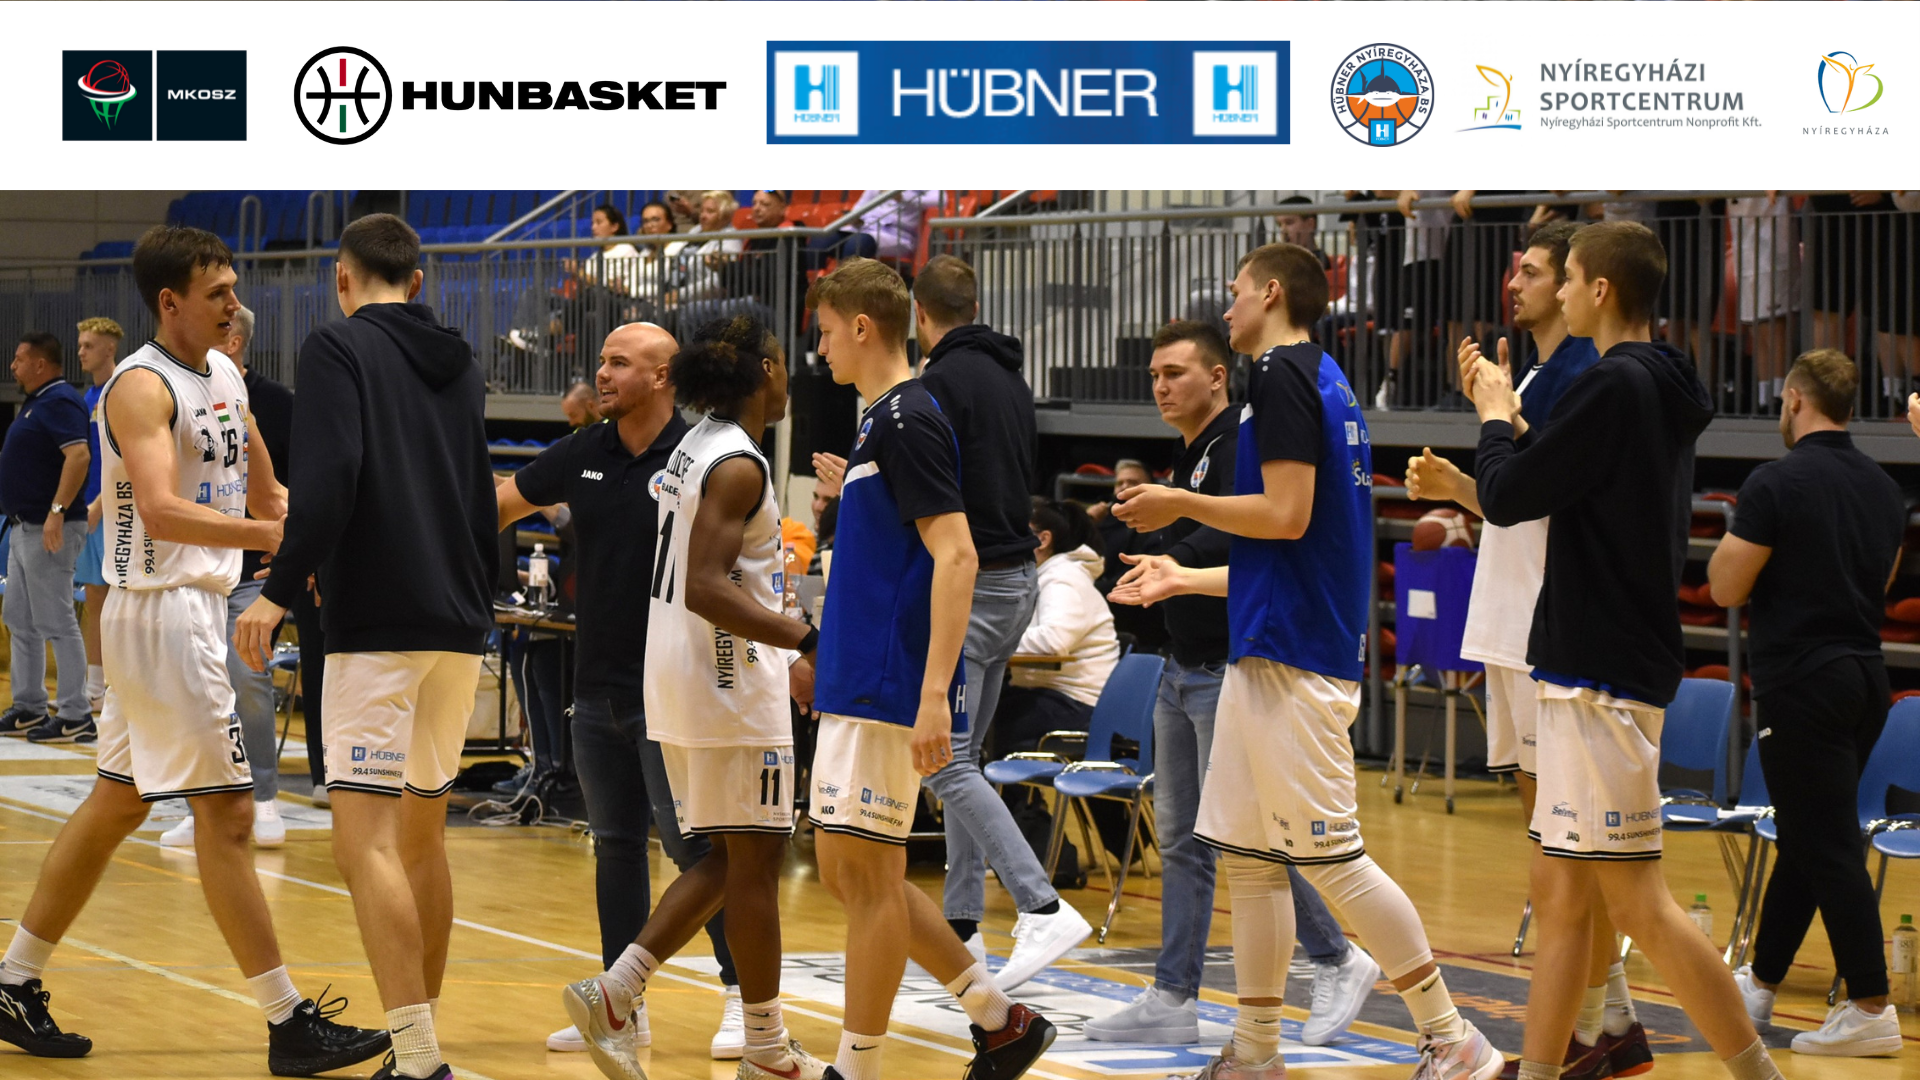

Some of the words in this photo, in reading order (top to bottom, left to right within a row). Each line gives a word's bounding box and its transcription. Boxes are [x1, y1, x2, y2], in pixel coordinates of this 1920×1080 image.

[581, 469, 604, 481] JAKO
[116, 481, 133, 499] BS
[144, 549, 155, 575] 99.4
[352, 767, 369, 776] 99.4
[760, 768, 780, 806] 11
